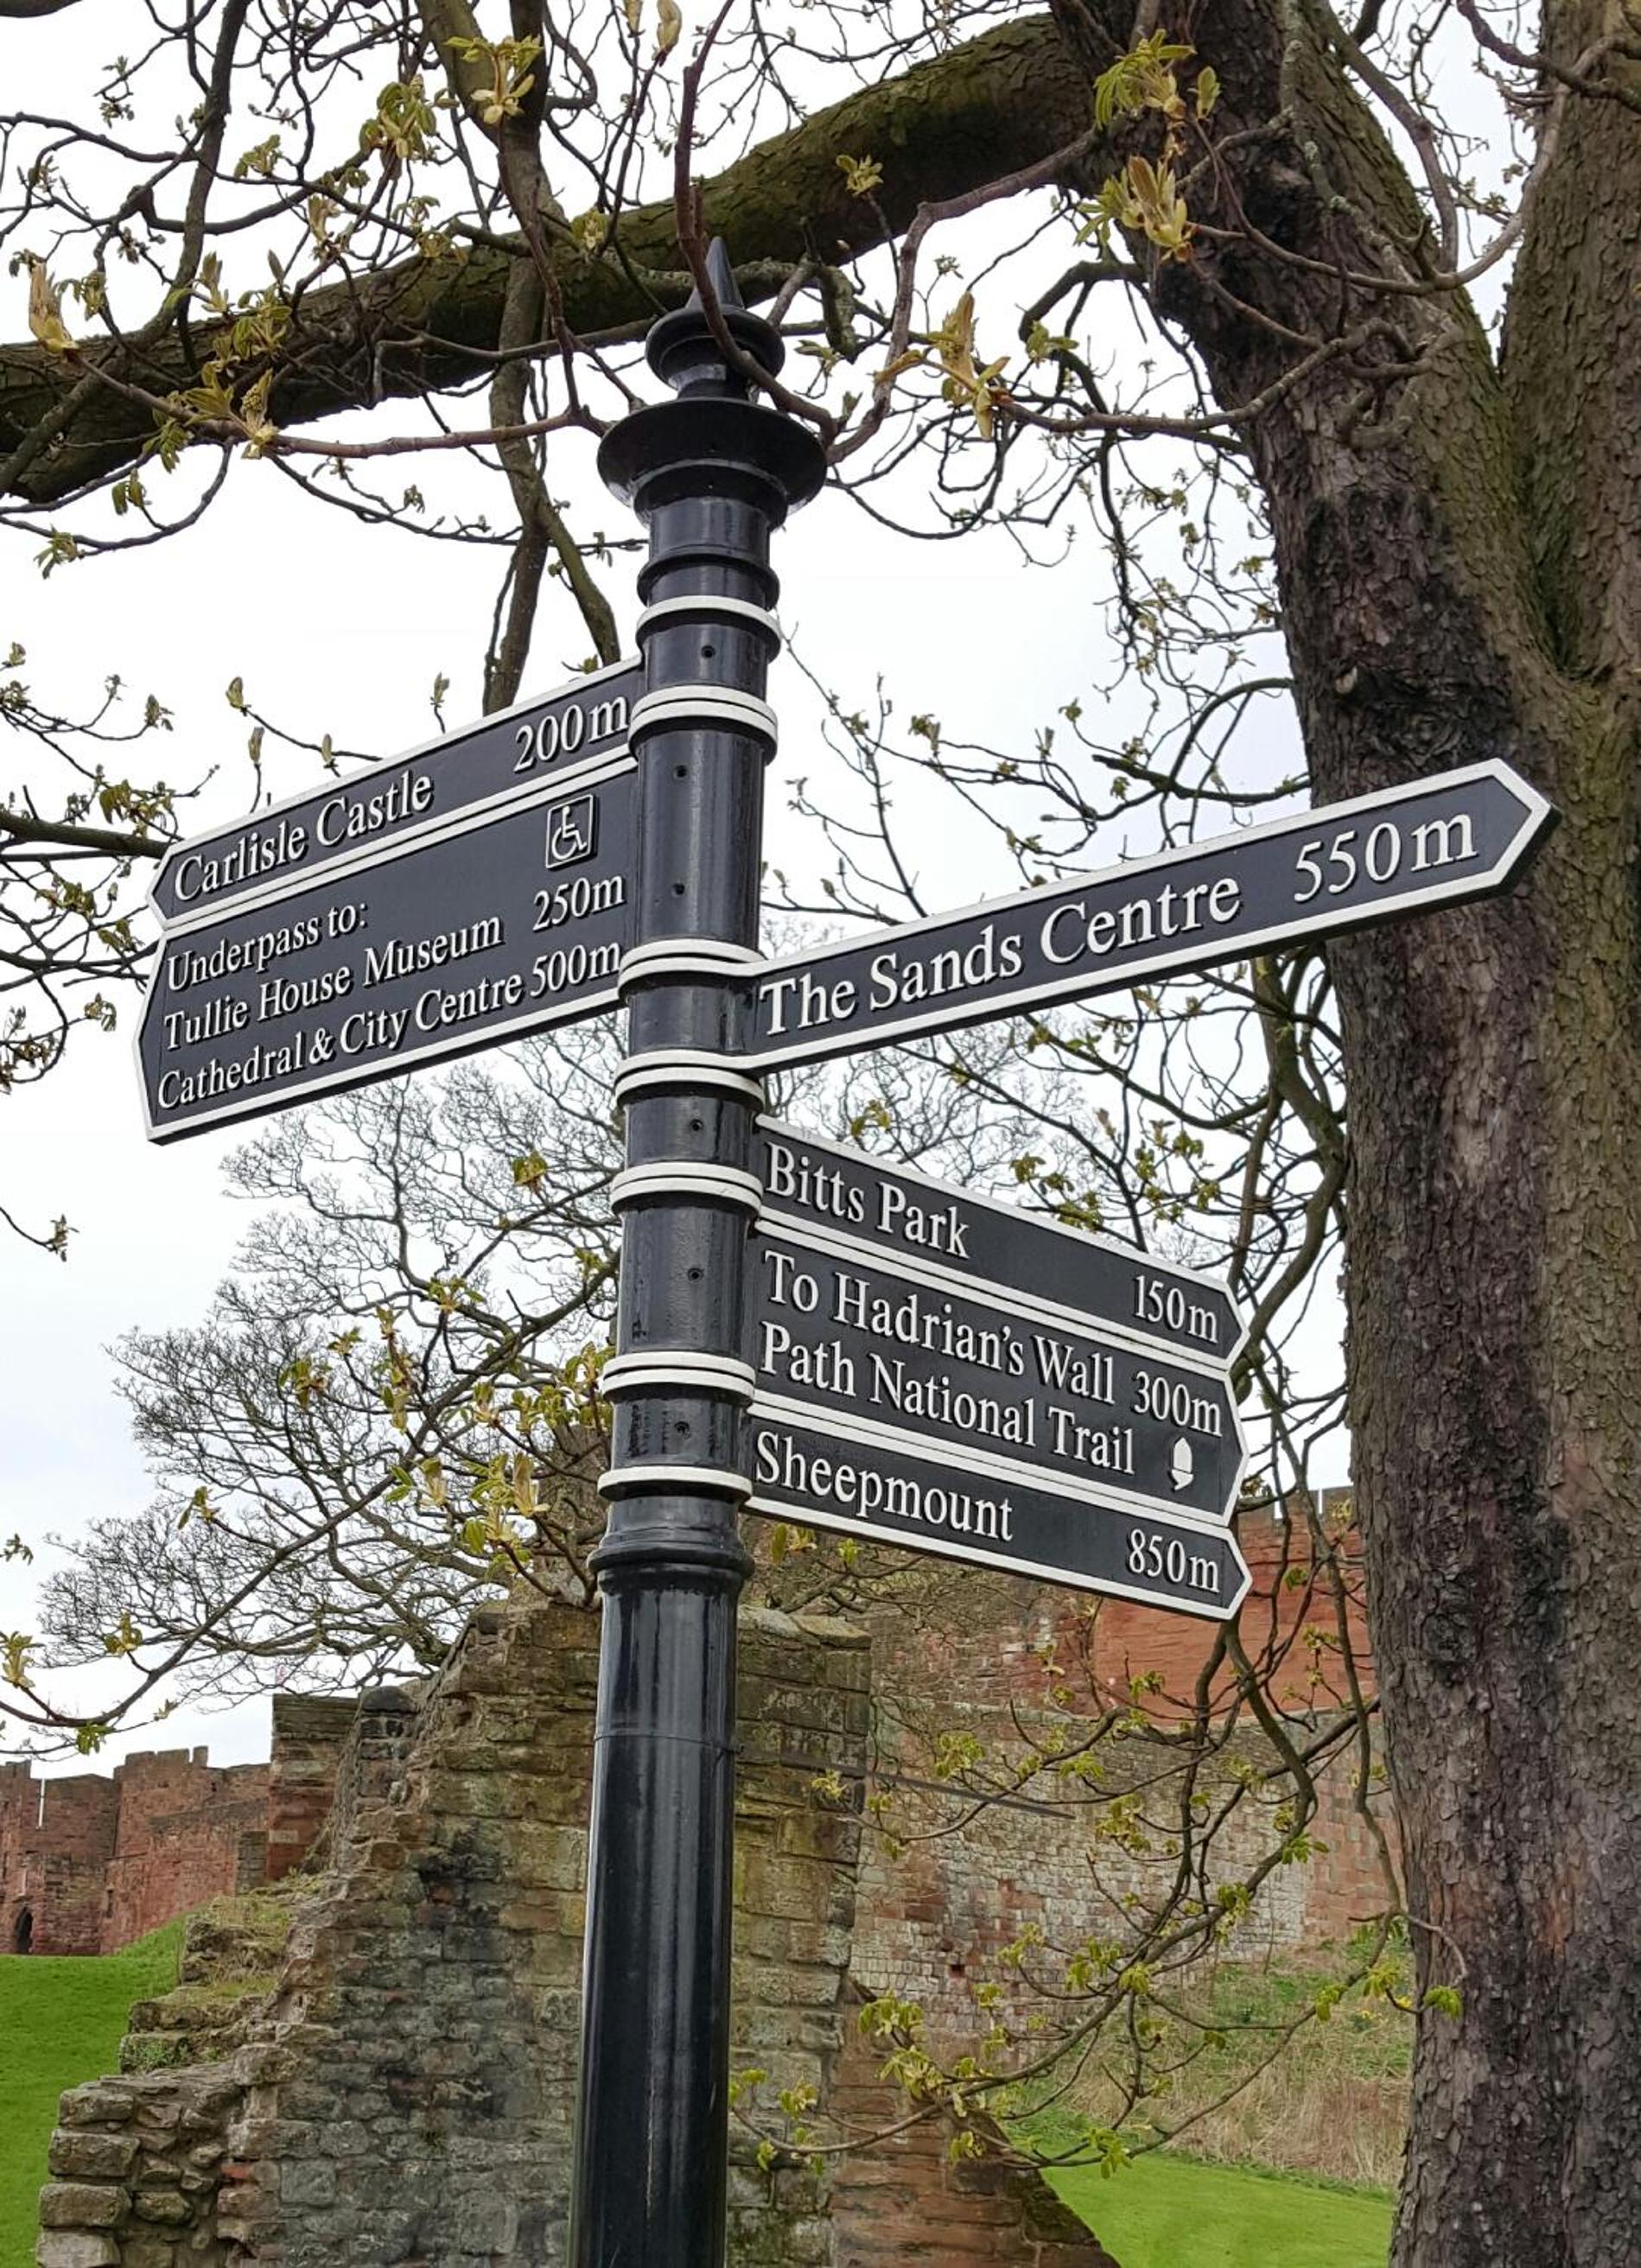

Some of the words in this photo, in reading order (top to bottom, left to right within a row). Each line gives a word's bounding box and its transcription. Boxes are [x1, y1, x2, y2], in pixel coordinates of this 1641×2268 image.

[174, 820, 307, 901] Carlisle
[315, 771, 434, 847] Castle
[158, 1029, 302, 1109] Cathedral
[309, 1029, 334, 1064] &
[340, 1006, 407, 1052] City
[416, 975, 523, 1031] Centre
[531, 943, 622, 997] 500m
[165, 996, 247, 1051] Tullie
[259, 963, 351, 1020] House
[365, 917, 501, 987] Museum
[533, 875, 624, 931] 250m
[168, 917, 319, 991] Underpass
[328, 901, 368, 937] to:
[760, 975, 857, 1036] The
[870, 924, 1022, 1012] Sands
[1041, 873, 1242, 964] Centre
[766, 1143, 863, 1223] Bitts
[877, 1182, 969, 1258] Park
[760, 1321, 855, 1396] Path
[870, 1353, 1035, 1446] National
[1048, 1407, 1134, 1474] Trail
[764, 1250, 819, 1312] To
[834, 1272, 1023, 1376] Hadrian's
[1031, 1336, 1115, 1404] Wall
[1133, 1371, 1222, 1436] 300m
[755, 1431, 1013, 1541] Sheepmount
[1129, 1529, 1219, 1592] 850m
